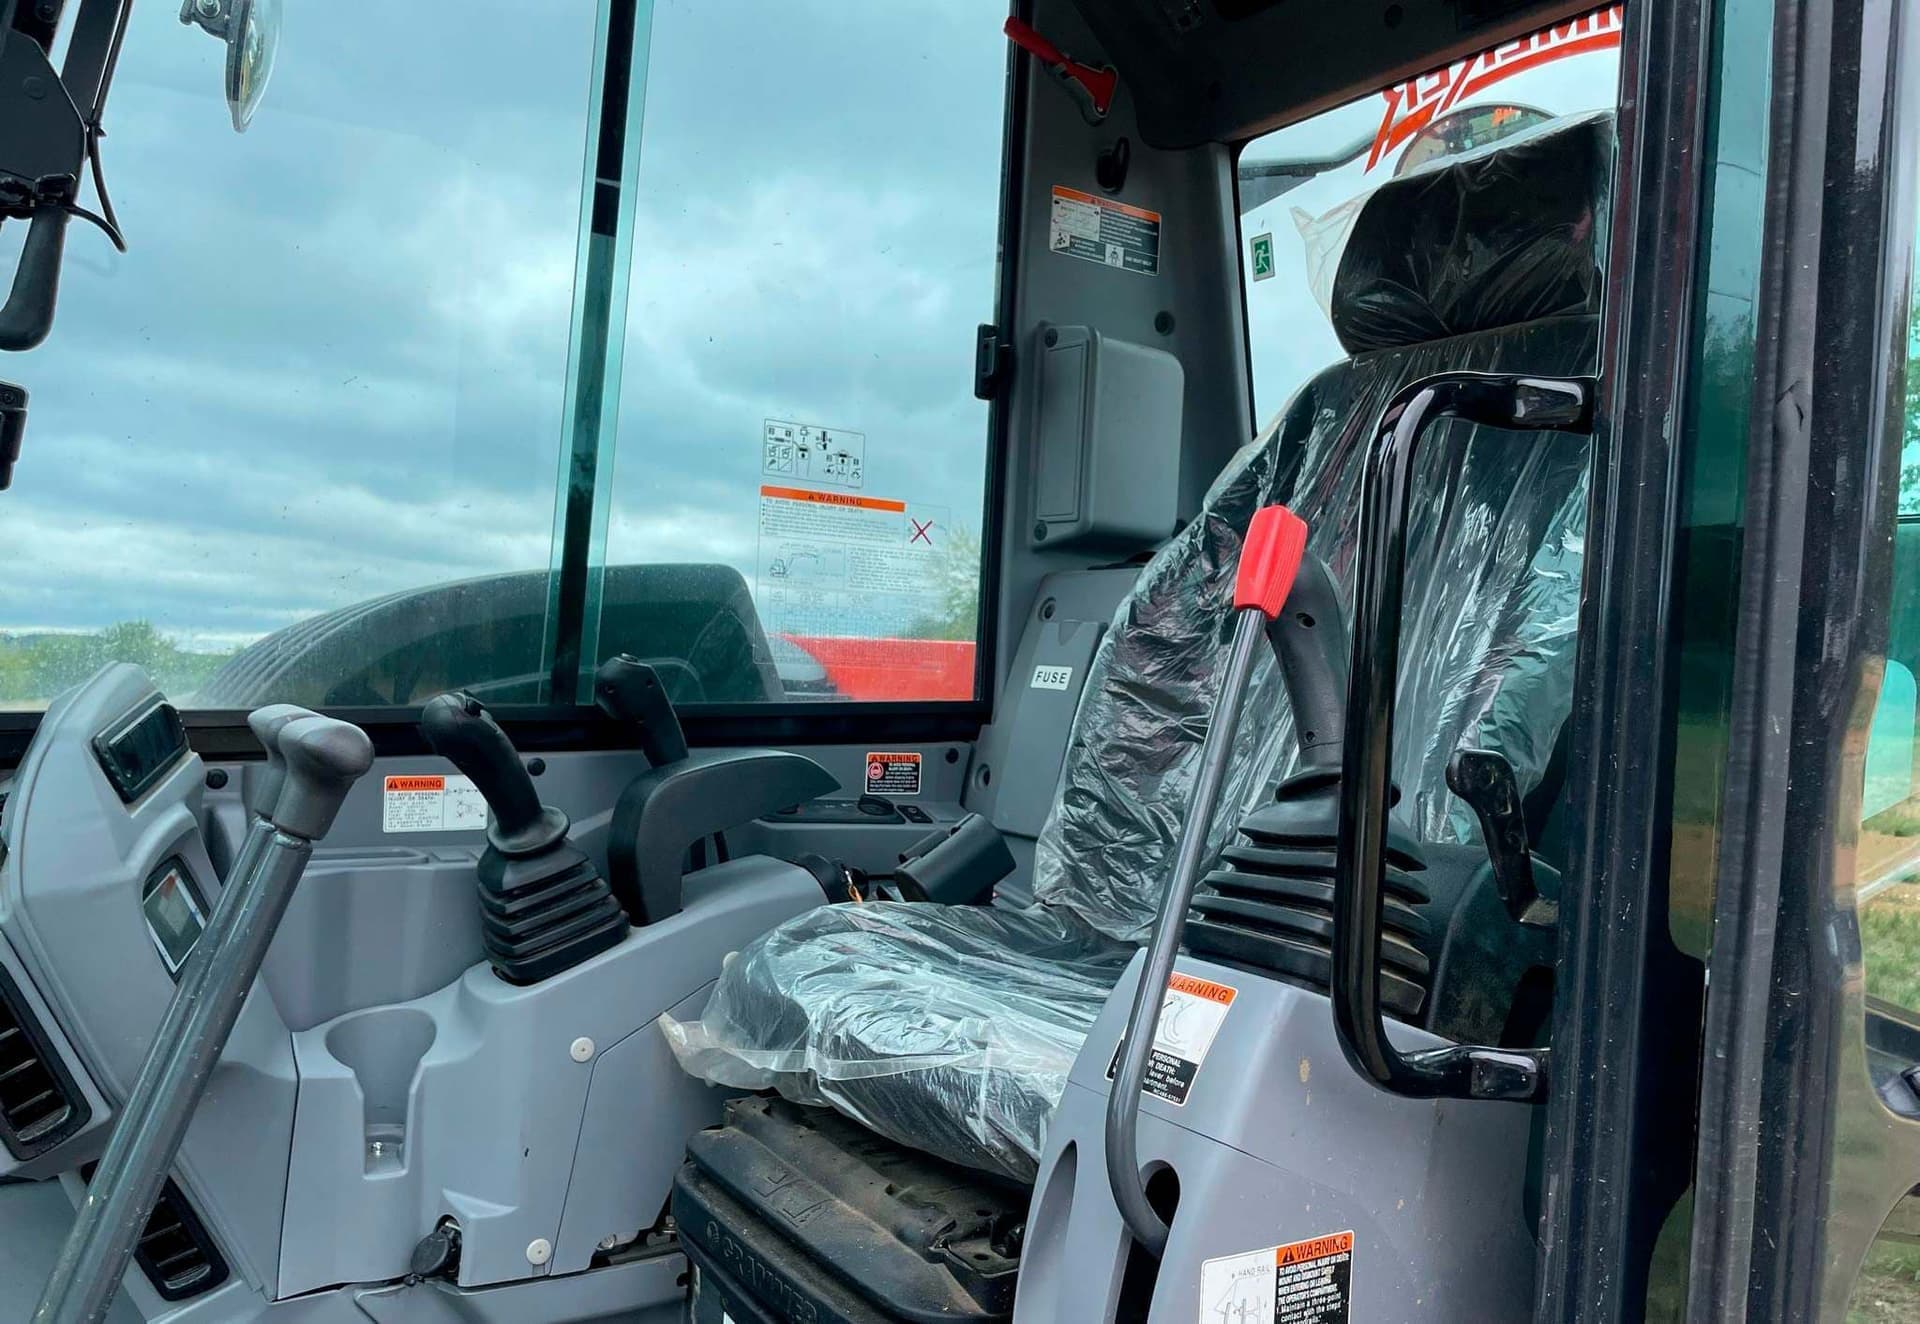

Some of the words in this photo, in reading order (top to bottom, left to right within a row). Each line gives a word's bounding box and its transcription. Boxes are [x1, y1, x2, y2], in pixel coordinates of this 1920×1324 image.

[819, 492, 862, 506] WARNING
[1035, 671, 1068, 684] FUSE
[400, 780, 442, 789] WARNING
[1152, 1051, 1181, 1068] PERSONAL
[1297, 1237, 1348, 1259] WARNING
